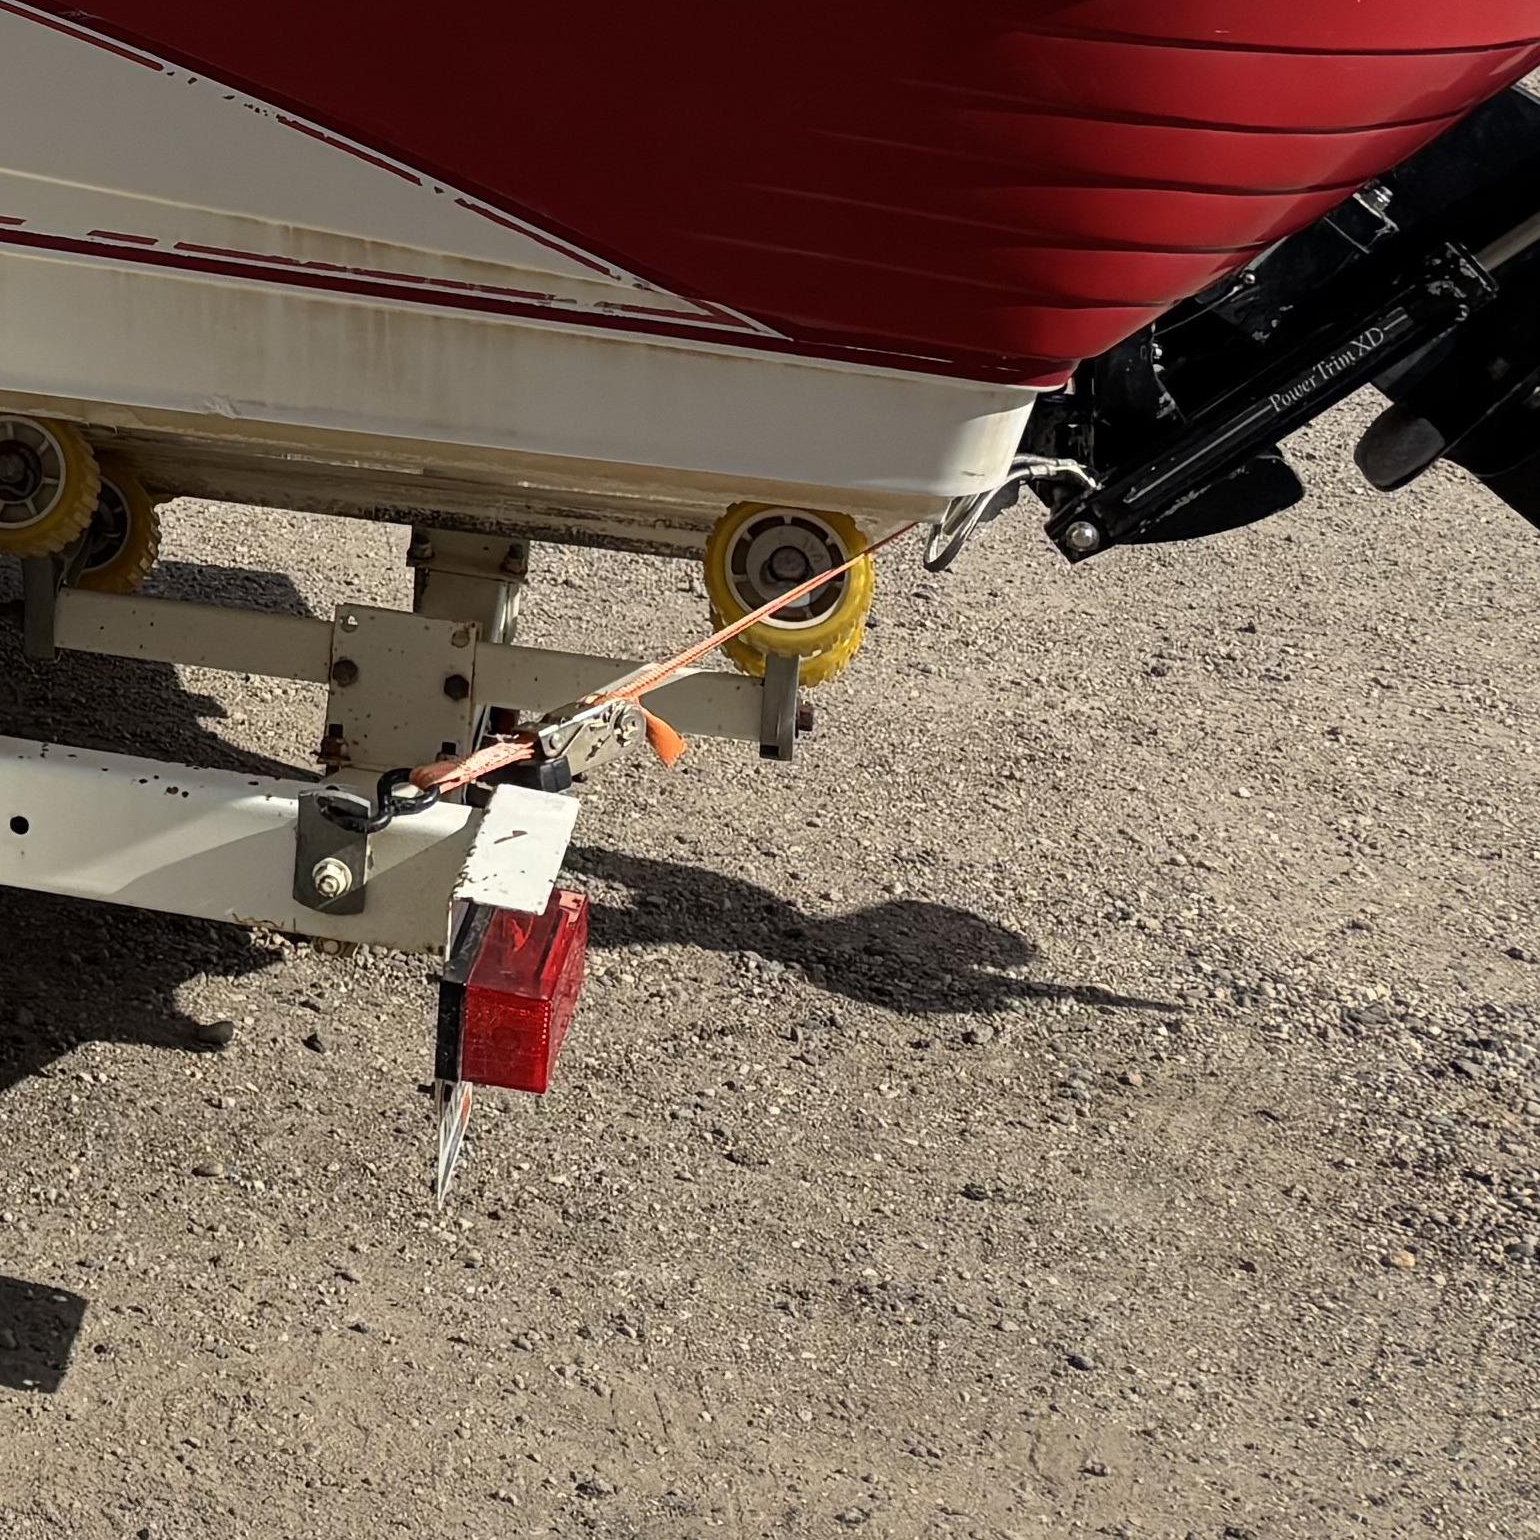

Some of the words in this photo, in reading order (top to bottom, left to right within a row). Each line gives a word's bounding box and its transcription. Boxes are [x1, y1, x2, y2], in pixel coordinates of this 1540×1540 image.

[1268, 374, 1317, 413] Power
[1312, 349, 1357, 380] Trim
[1349, 327, 1384, 357] XD
